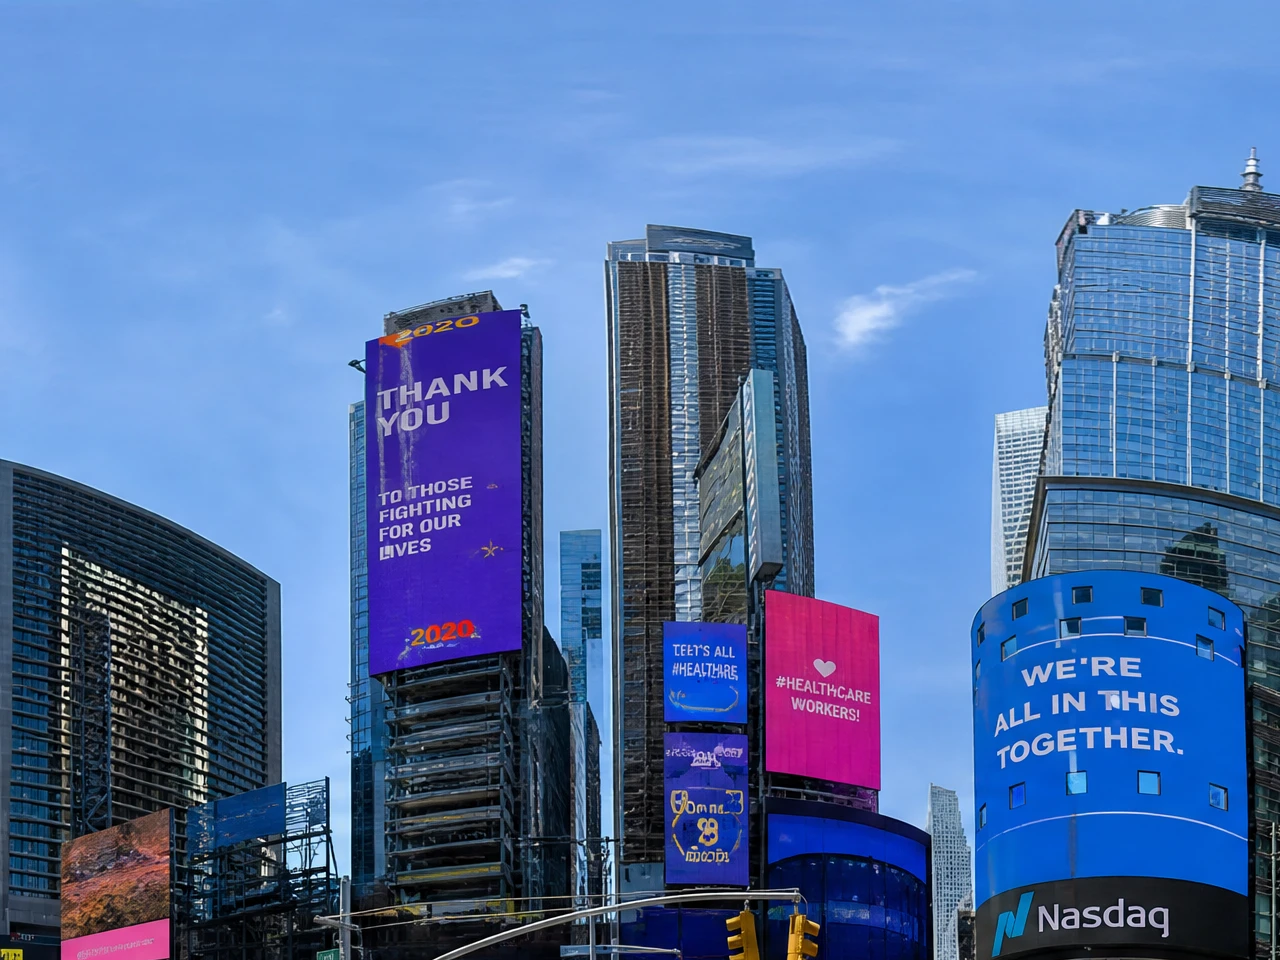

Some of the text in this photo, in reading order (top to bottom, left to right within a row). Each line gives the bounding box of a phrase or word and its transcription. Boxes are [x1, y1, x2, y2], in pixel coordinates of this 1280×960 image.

[377, 366, 508, 410] THANK
[377, 401, 451, 437] YOU
[378, 476, 473, 506] TO THOSE
[379, 494, 472, 523] FIGHTING
[379, 513, 461, 542] FOR OUR
[410, 618, 475, 647] 2020
[714, 646, 736, 658] ALL
[1021, 657, 1142, 687] WE'RE
[791, 696, 861, 722] WORKERS!
[994, 690, 1180, 738] ALL IN THIS
[996, 726, 1184, 769] TOGETHER.
[1038, 898, 1170, 938] Nasdaq
